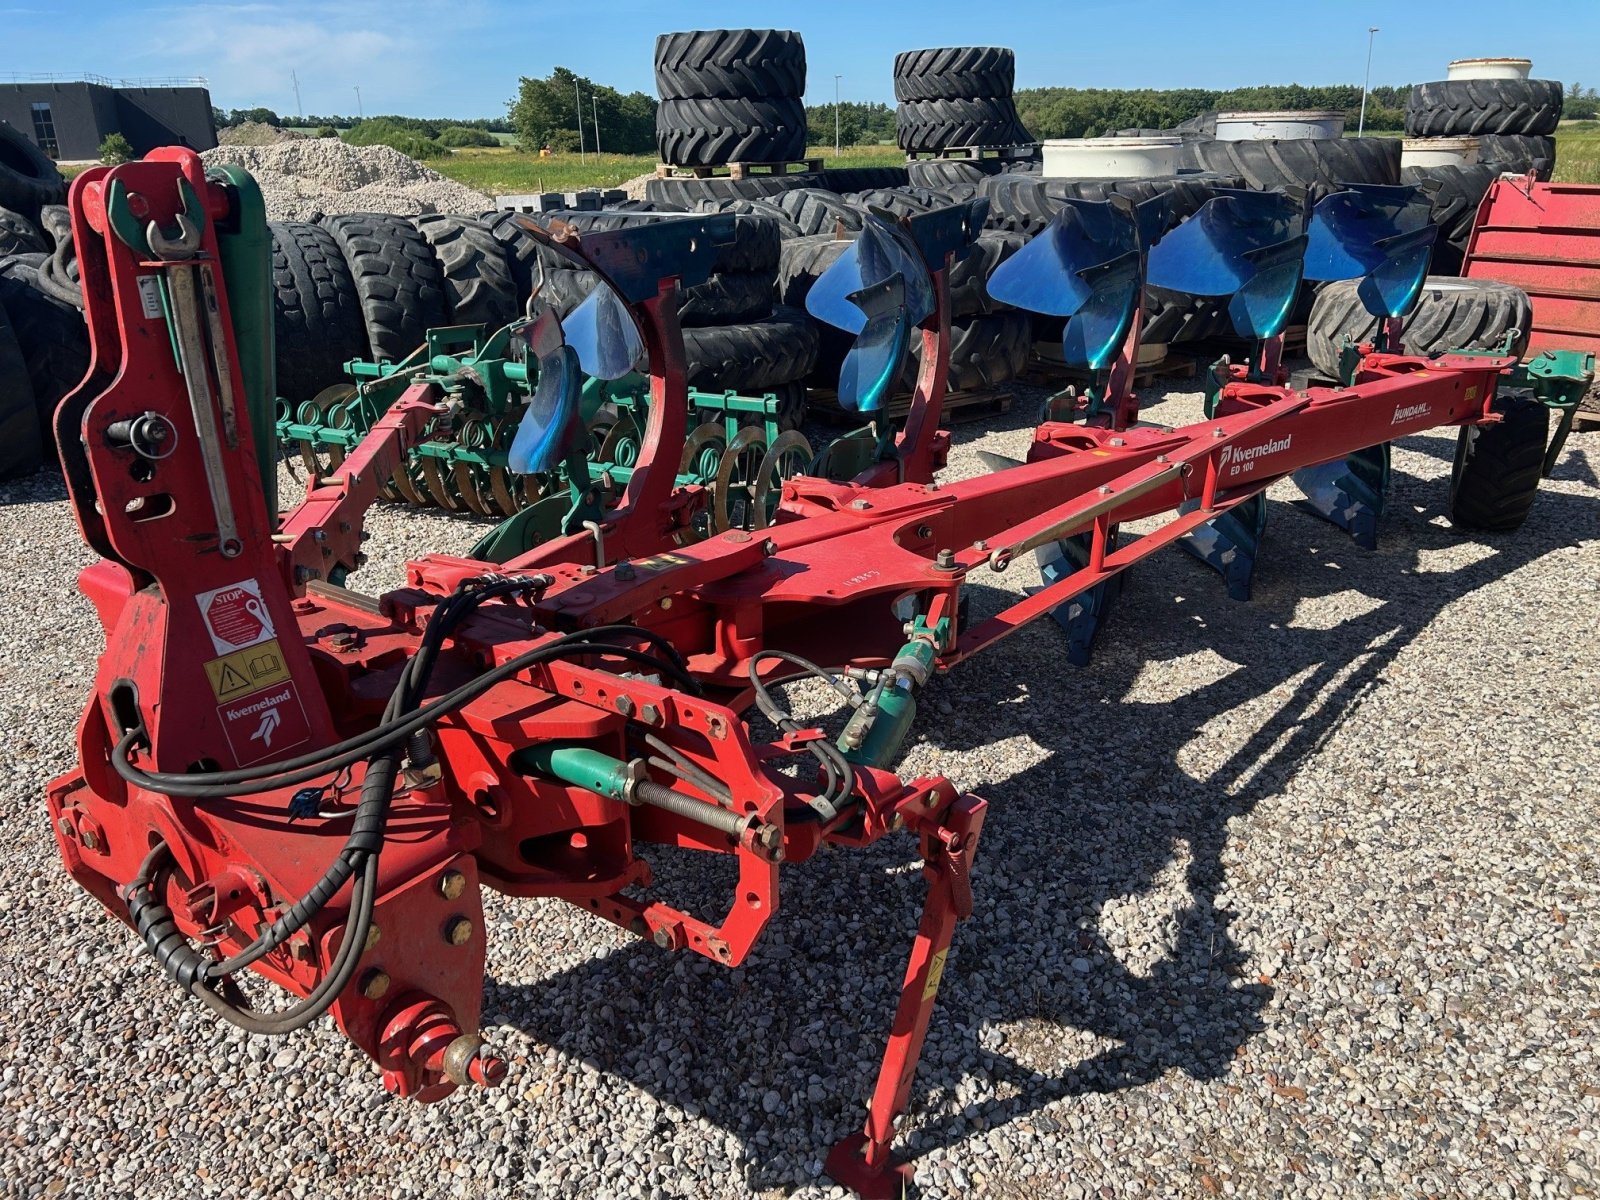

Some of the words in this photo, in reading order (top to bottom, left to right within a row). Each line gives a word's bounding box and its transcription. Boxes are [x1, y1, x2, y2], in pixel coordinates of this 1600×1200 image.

[1232, 434, 1292, 463] Kverneland
[1230, 465, 1240, 476] ED
[1243, 461, 1254, 473] 100
[215, 589, 244, 605] STOP!
[226, 689, 291, 721] Kverneland
